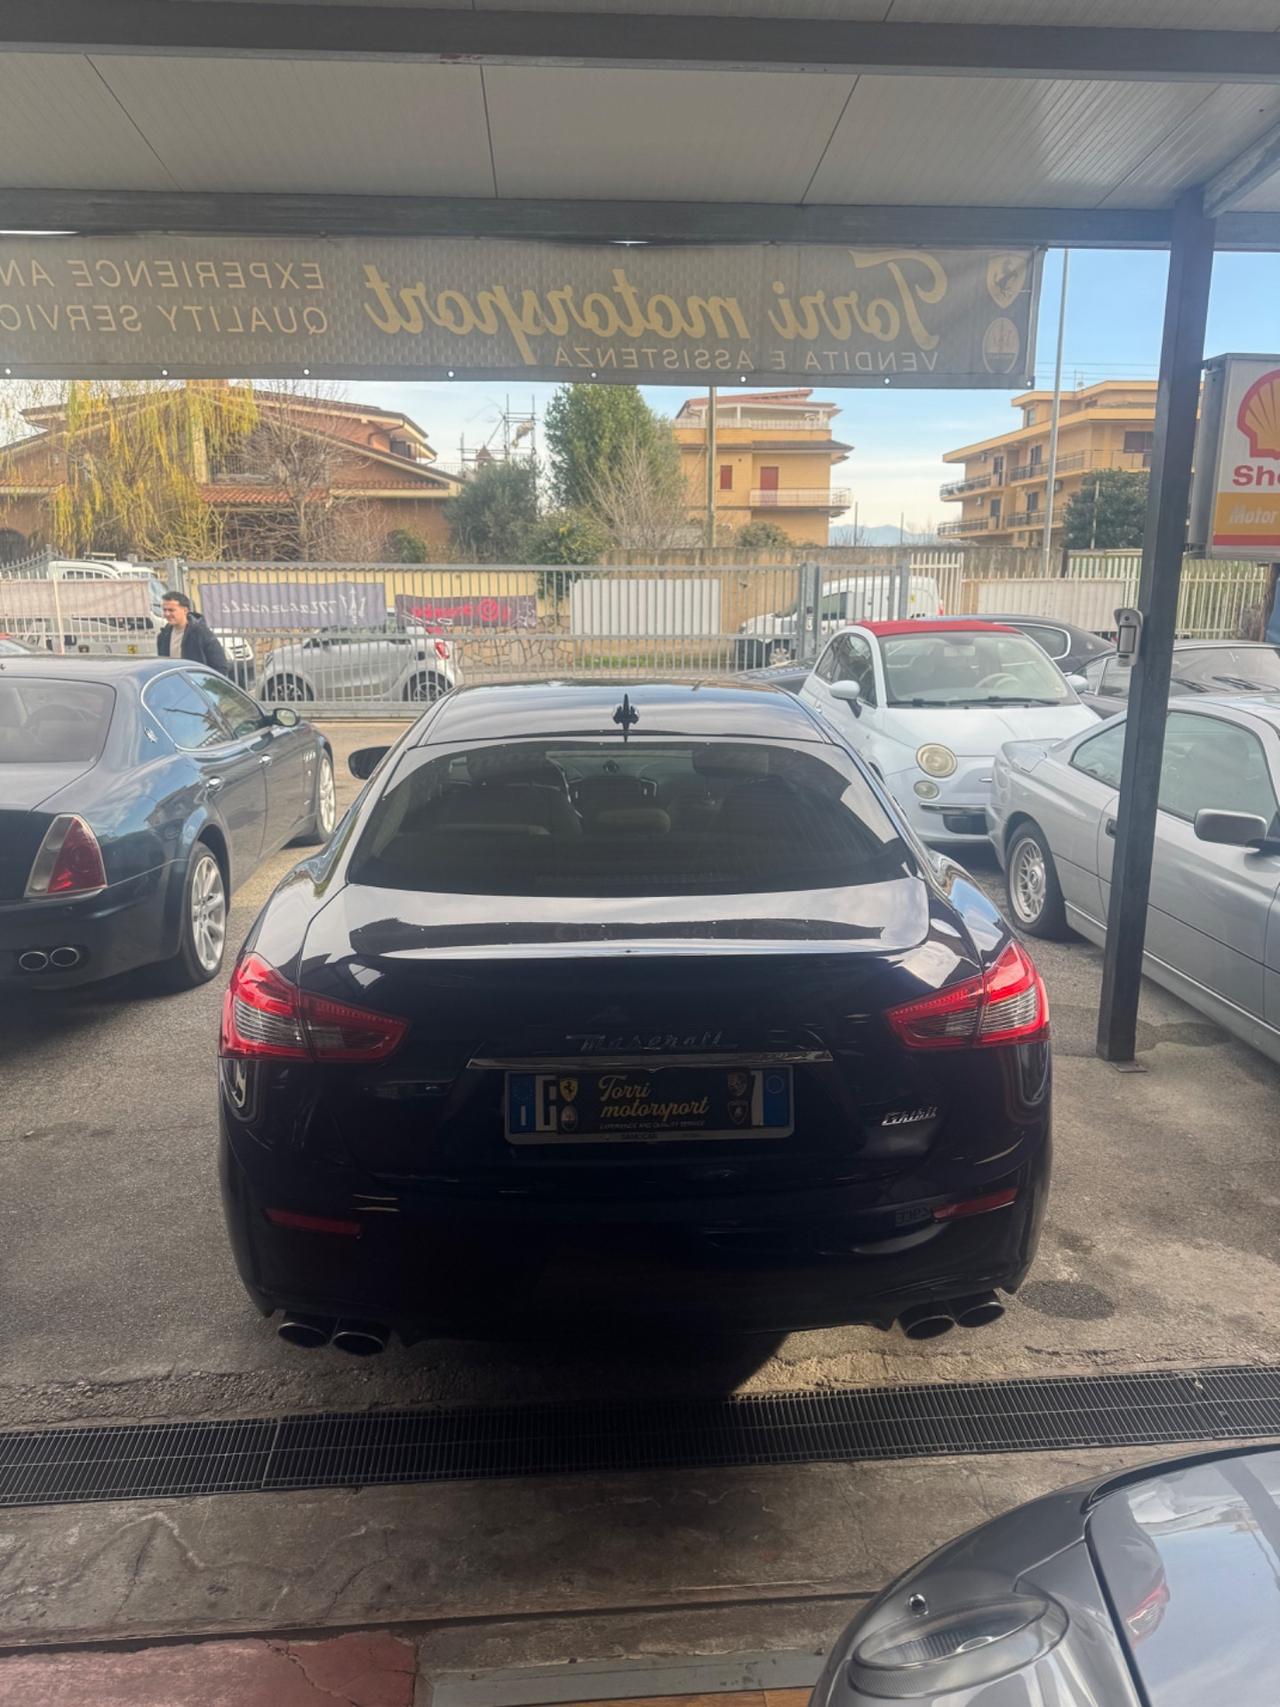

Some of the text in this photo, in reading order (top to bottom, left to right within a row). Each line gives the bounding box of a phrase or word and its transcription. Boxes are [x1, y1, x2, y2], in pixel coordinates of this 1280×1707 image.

[1232, 464, 1280, 486] Sh
[598, 1075, 651, 1100] Torri
[600, 1096, 711, 1122] motorsport
